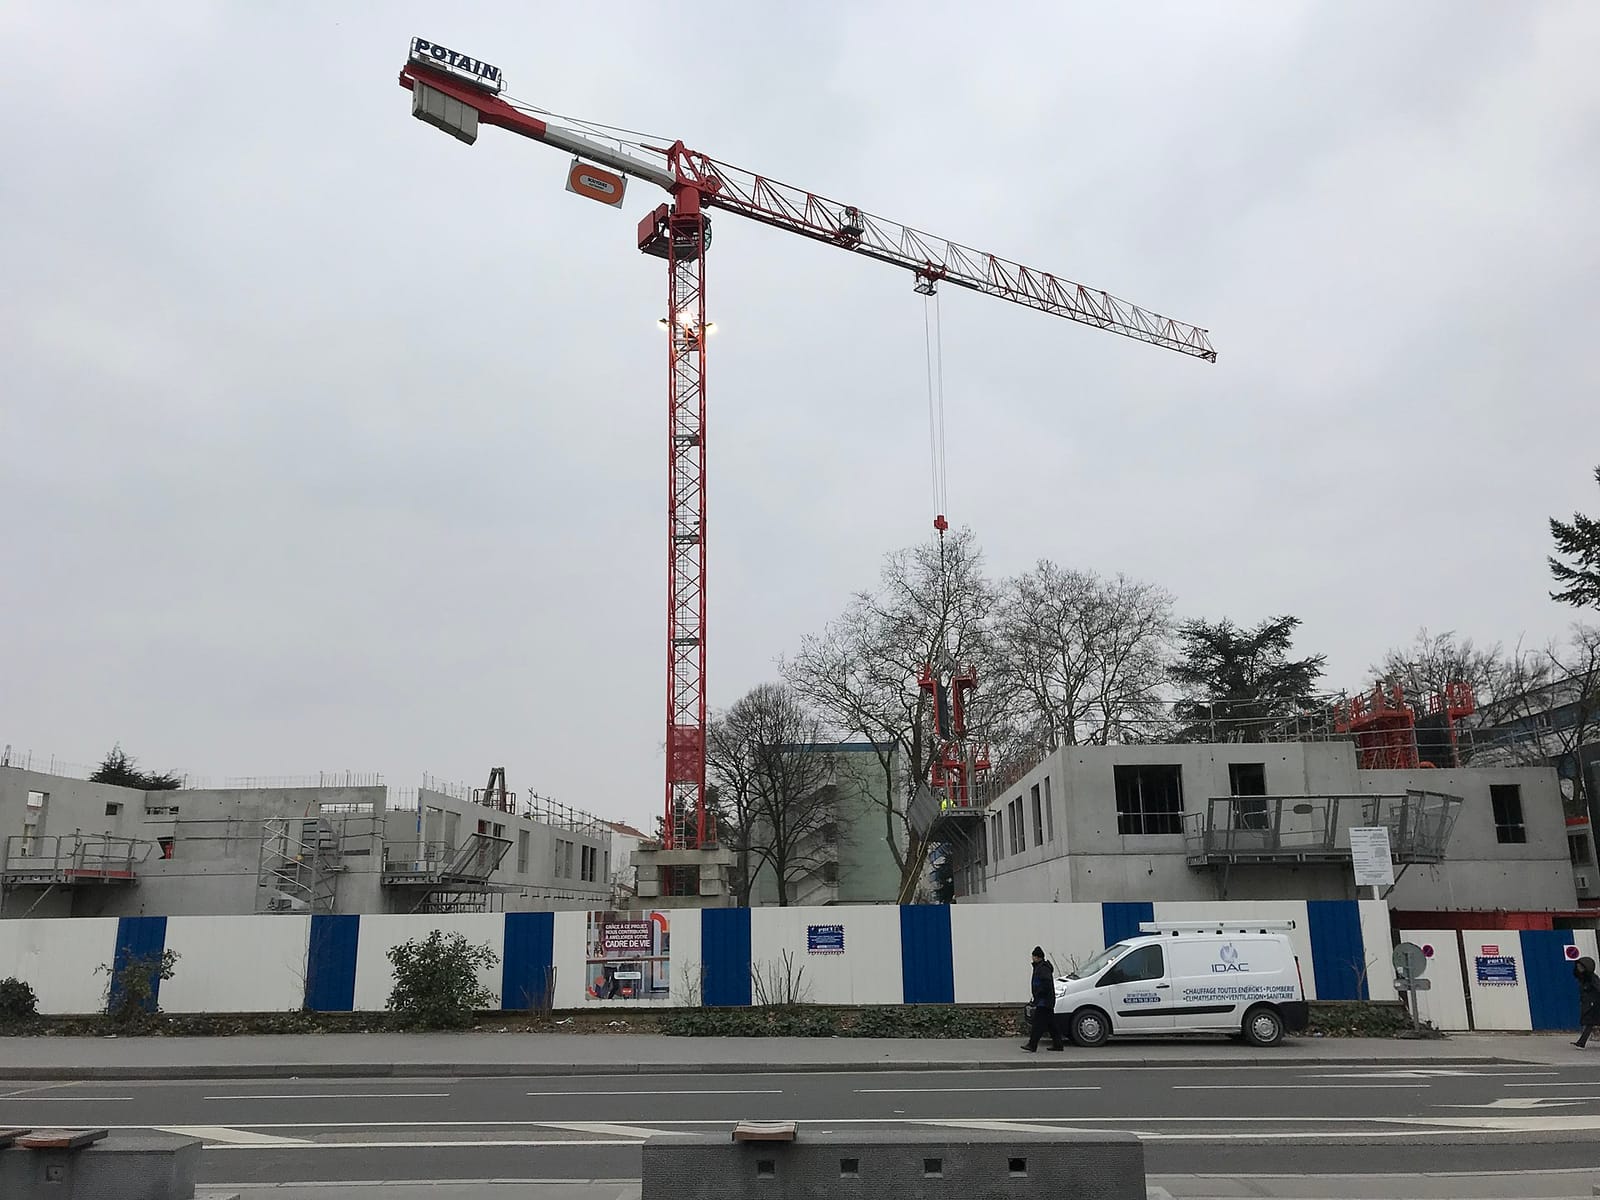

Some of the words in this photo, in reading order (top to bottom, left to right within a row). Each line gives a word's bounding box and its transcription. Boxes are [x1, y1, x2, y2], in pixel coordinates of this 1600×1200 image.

[414, 38, 499, 81] POTAIN
[605, 940, 628, 948] CADRE
[1211, 962, 1249, 973] IDAC
[1217, 986, 1237, 994] TOUTES
